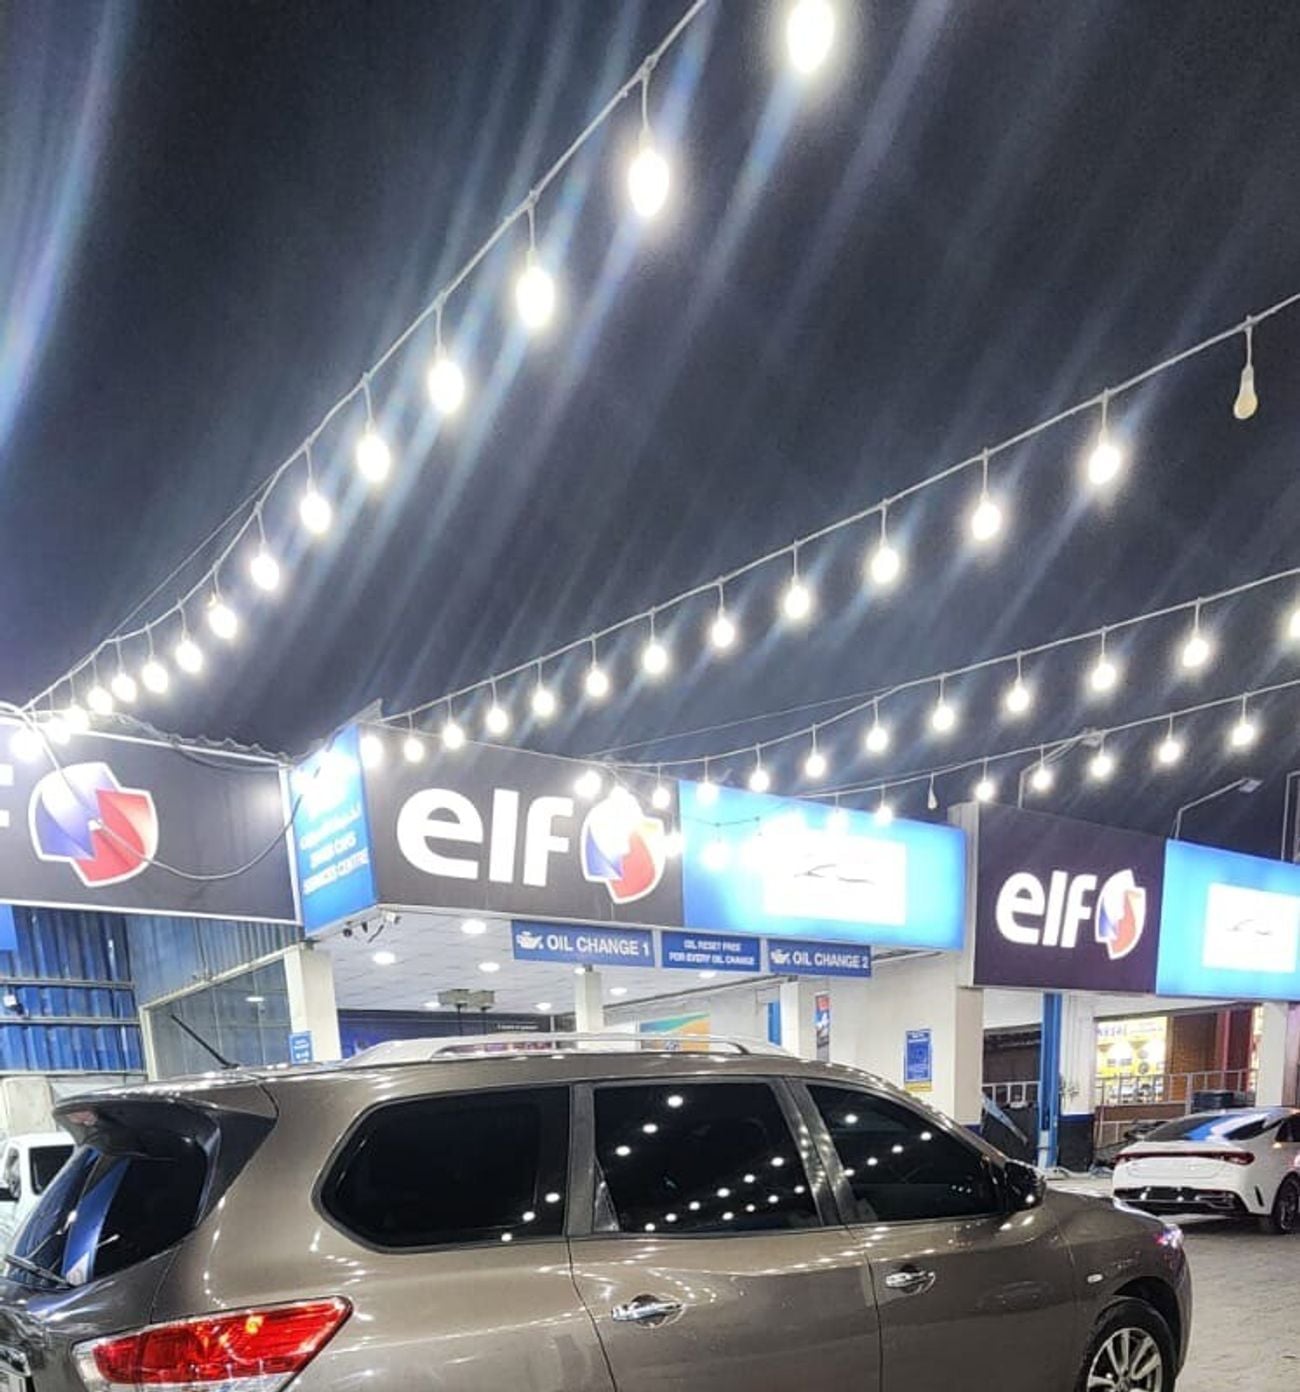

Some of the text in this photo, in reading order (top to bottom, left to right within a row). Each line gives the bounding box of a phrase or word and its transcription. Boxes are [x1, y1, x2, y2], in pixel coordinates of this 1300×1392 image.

[397, 788, 574, 887] elf
[996, 870, 1098, 948] elf
[547, 935, 649, 956] OIL CHANGE 1
[669, 951, 754, 966] FOR EVERY OIL CHANGE
[792, 950, 869, 969] OIL CHANGE 2
